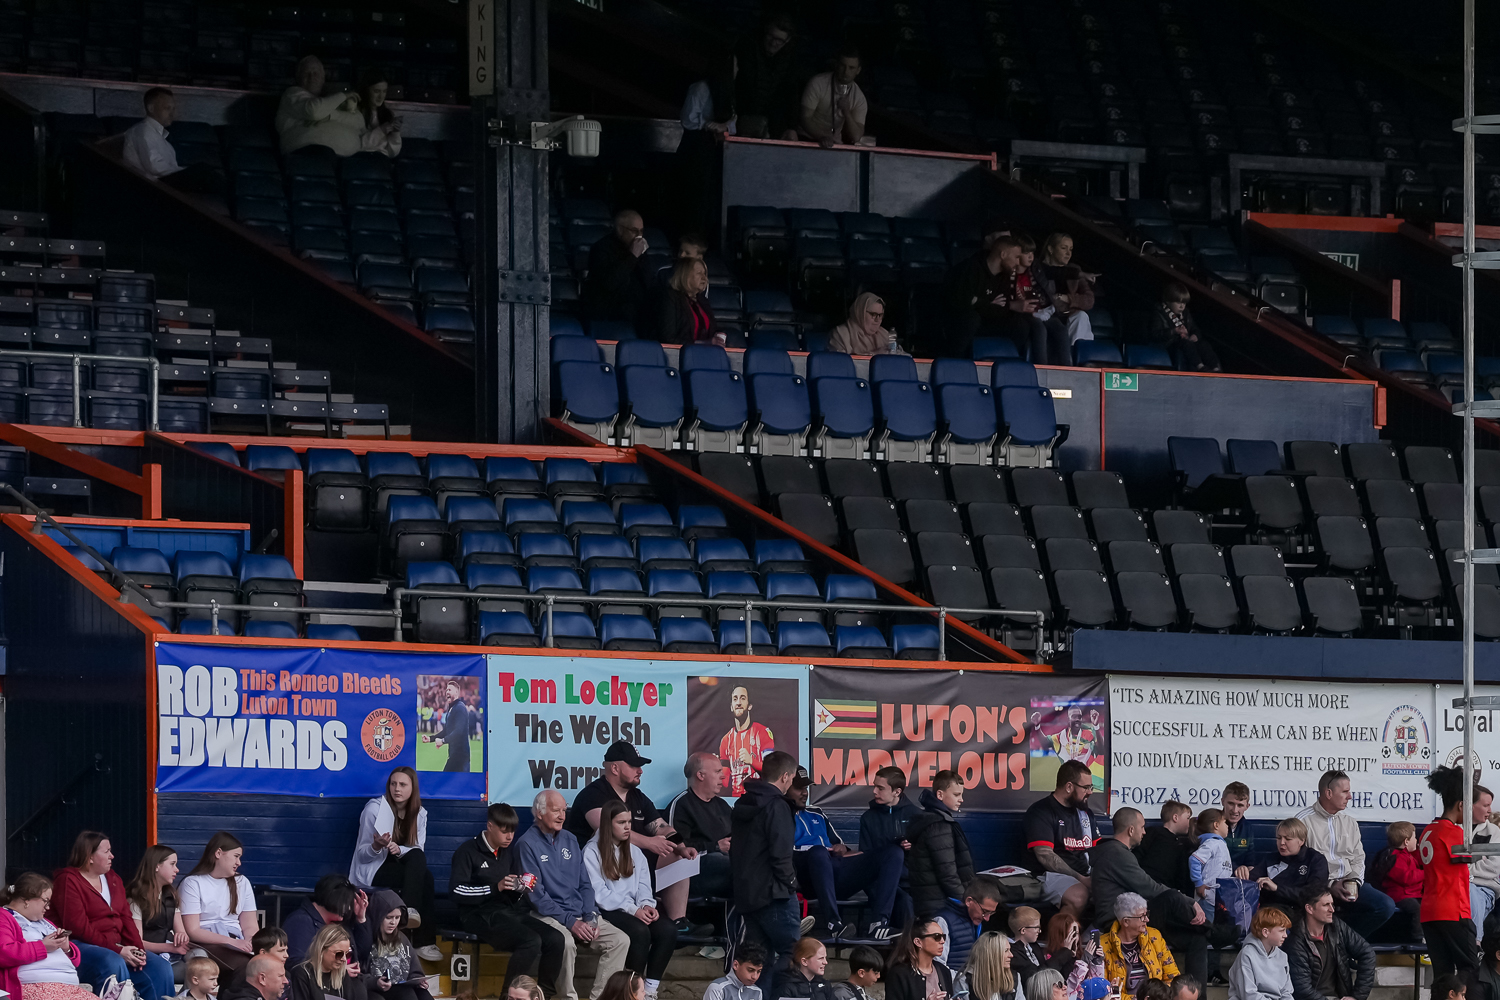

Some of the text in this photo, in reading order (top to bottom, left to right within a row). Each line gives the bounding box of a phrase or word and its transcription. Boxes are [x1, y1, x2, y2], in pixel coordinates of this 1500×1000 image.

[158, 664, 238, 716] ROB
[240, 669, 402, 695] This Romeo Bleeds
[498, 672, 674, 712] Tom Lockyer
[241, 693, 337, 716] Luton Town
[1148, 687, 1222, 706] AMAZING
[1225, 689, 1261, 707] HOW
[1263, 692, 1303, 708] MUCH
[1307, 693, 1350, 709] MORE
[365, 710, 402, 726] LUTON TOWN
[514, 713, 651, 746] The Welsh
[881, 703, 1028, 744] LUTON'S
[1112, 720, 1379, 743] SUCCESSFUL A TEAM CAN BE WHEN
[159, 717, 348, 770] EDWARDS
[364, 743, 402, 762] FOOTBALL CLUB
[1112, 750, 1378, 773] NO INDIVIDUAL TAKES THE CREDIT”
[528, 759, 604, 791] Warr
[1121, 786, 1182, 805] FORZA
[1188, 787, 1223, 805] 202
[1252, 789, 1308, 807] LUTON
[1350, 791, 1373, 808] HE
[1378, 790, 1424, 809] CORE
[453, 957, 467, 978] G
